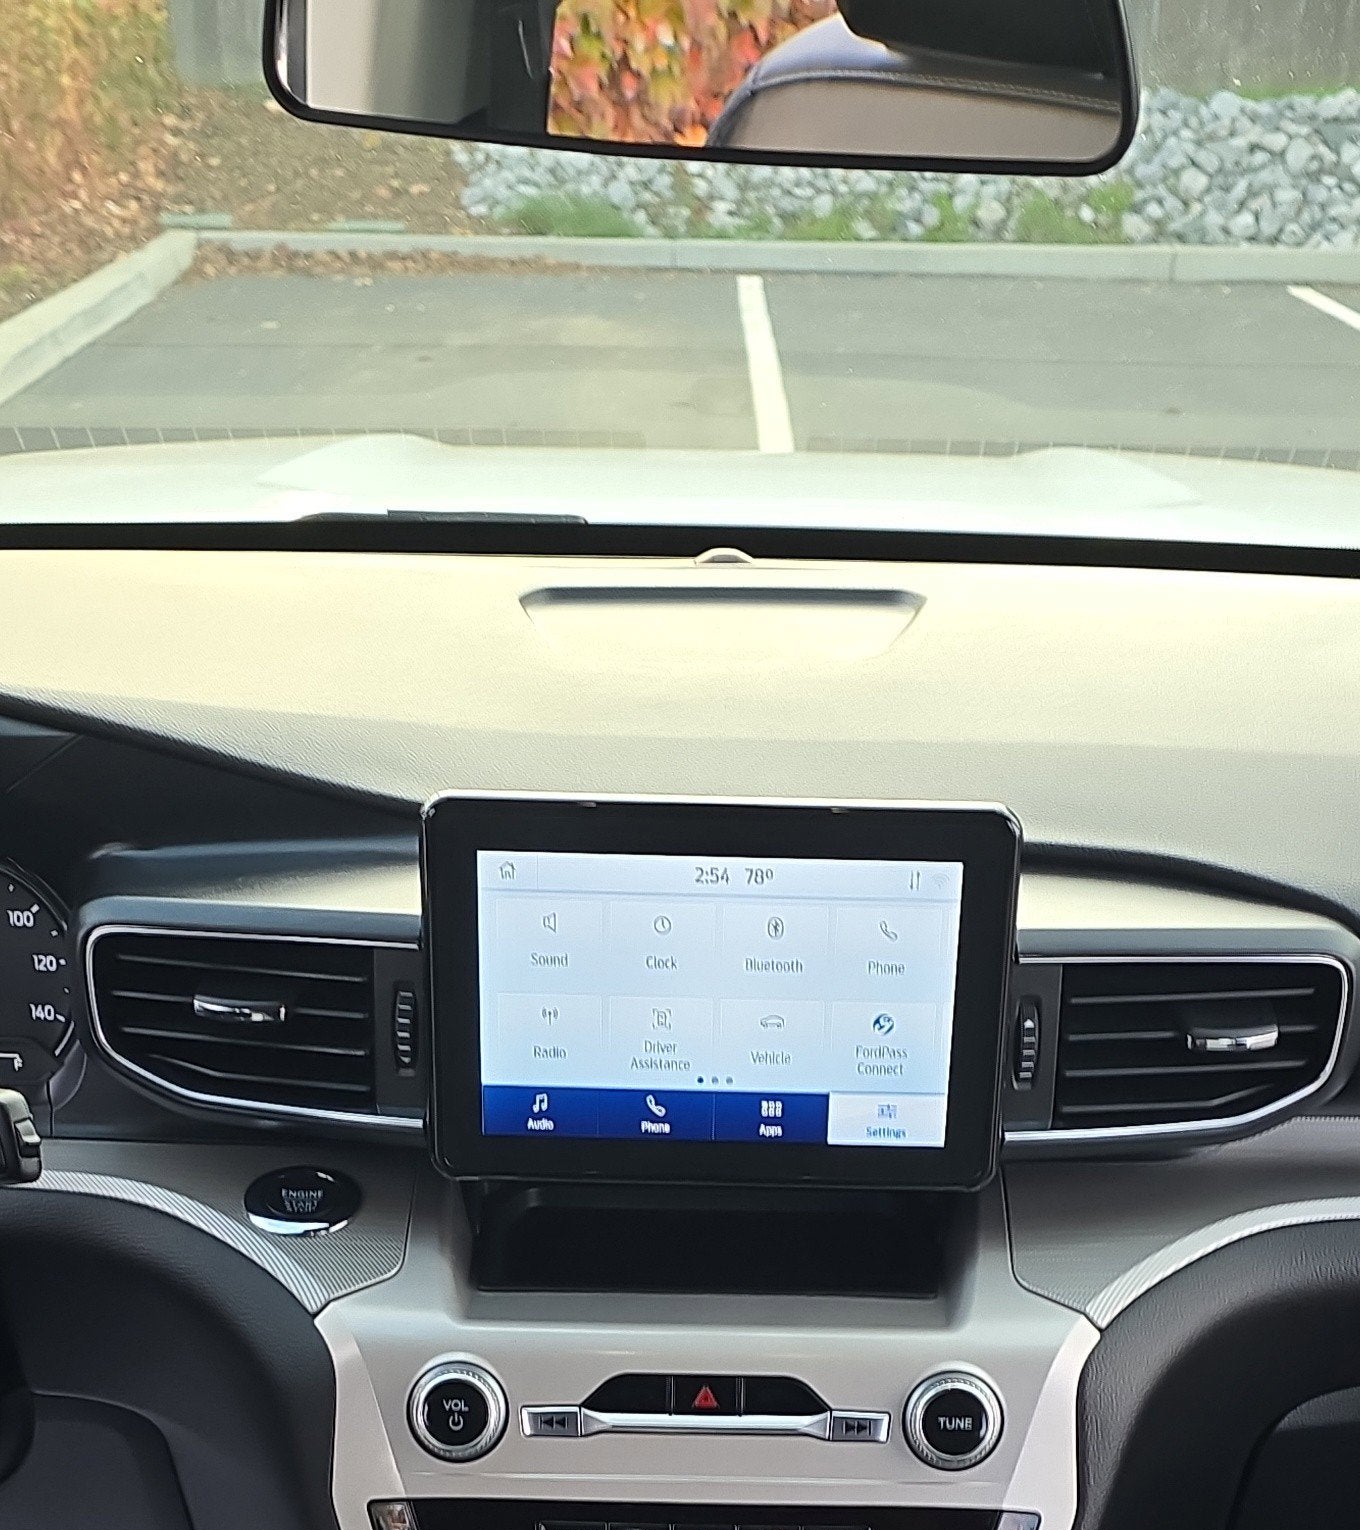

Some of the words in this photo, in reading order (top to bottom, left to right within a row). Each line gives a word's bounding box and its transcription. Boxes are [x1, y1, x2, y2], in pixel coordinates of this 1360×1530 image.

[694, 866, 730, 885] 2:54
[7, 909, 34, 927] 100
[32, 954, 57, 972] 120
[530, 952, 569, 967] Sound
[645, 955, 678, 970] Clock
[745, 957, 803, 973] Bluetooth
[868, 960, 905, 975] Phone
[30, 1003, 55, 1021] 140
[533, 1045, 567, 1059] Radio
[644, 1040, 678, 1054] Driver
[855, 1045, 908, 1060] FordPass
[630, 1056, 691, 1071] Assistance
[751, 1051, 792, 1065] Vehicle
[857, 1062, 904, 1076] Connect
[527, 1117, 555, 1131] Audio
[641, 1120, 671, 1134] Phone
[759, 1123, 783, 1138] Apps
[866, 1126, 907, 1139] Settings
[281, 1187, 324, 1200] ENGINE
[443, 1399, 469, 1414] VOL
[938, 1416, 973, 1431] TUNE
